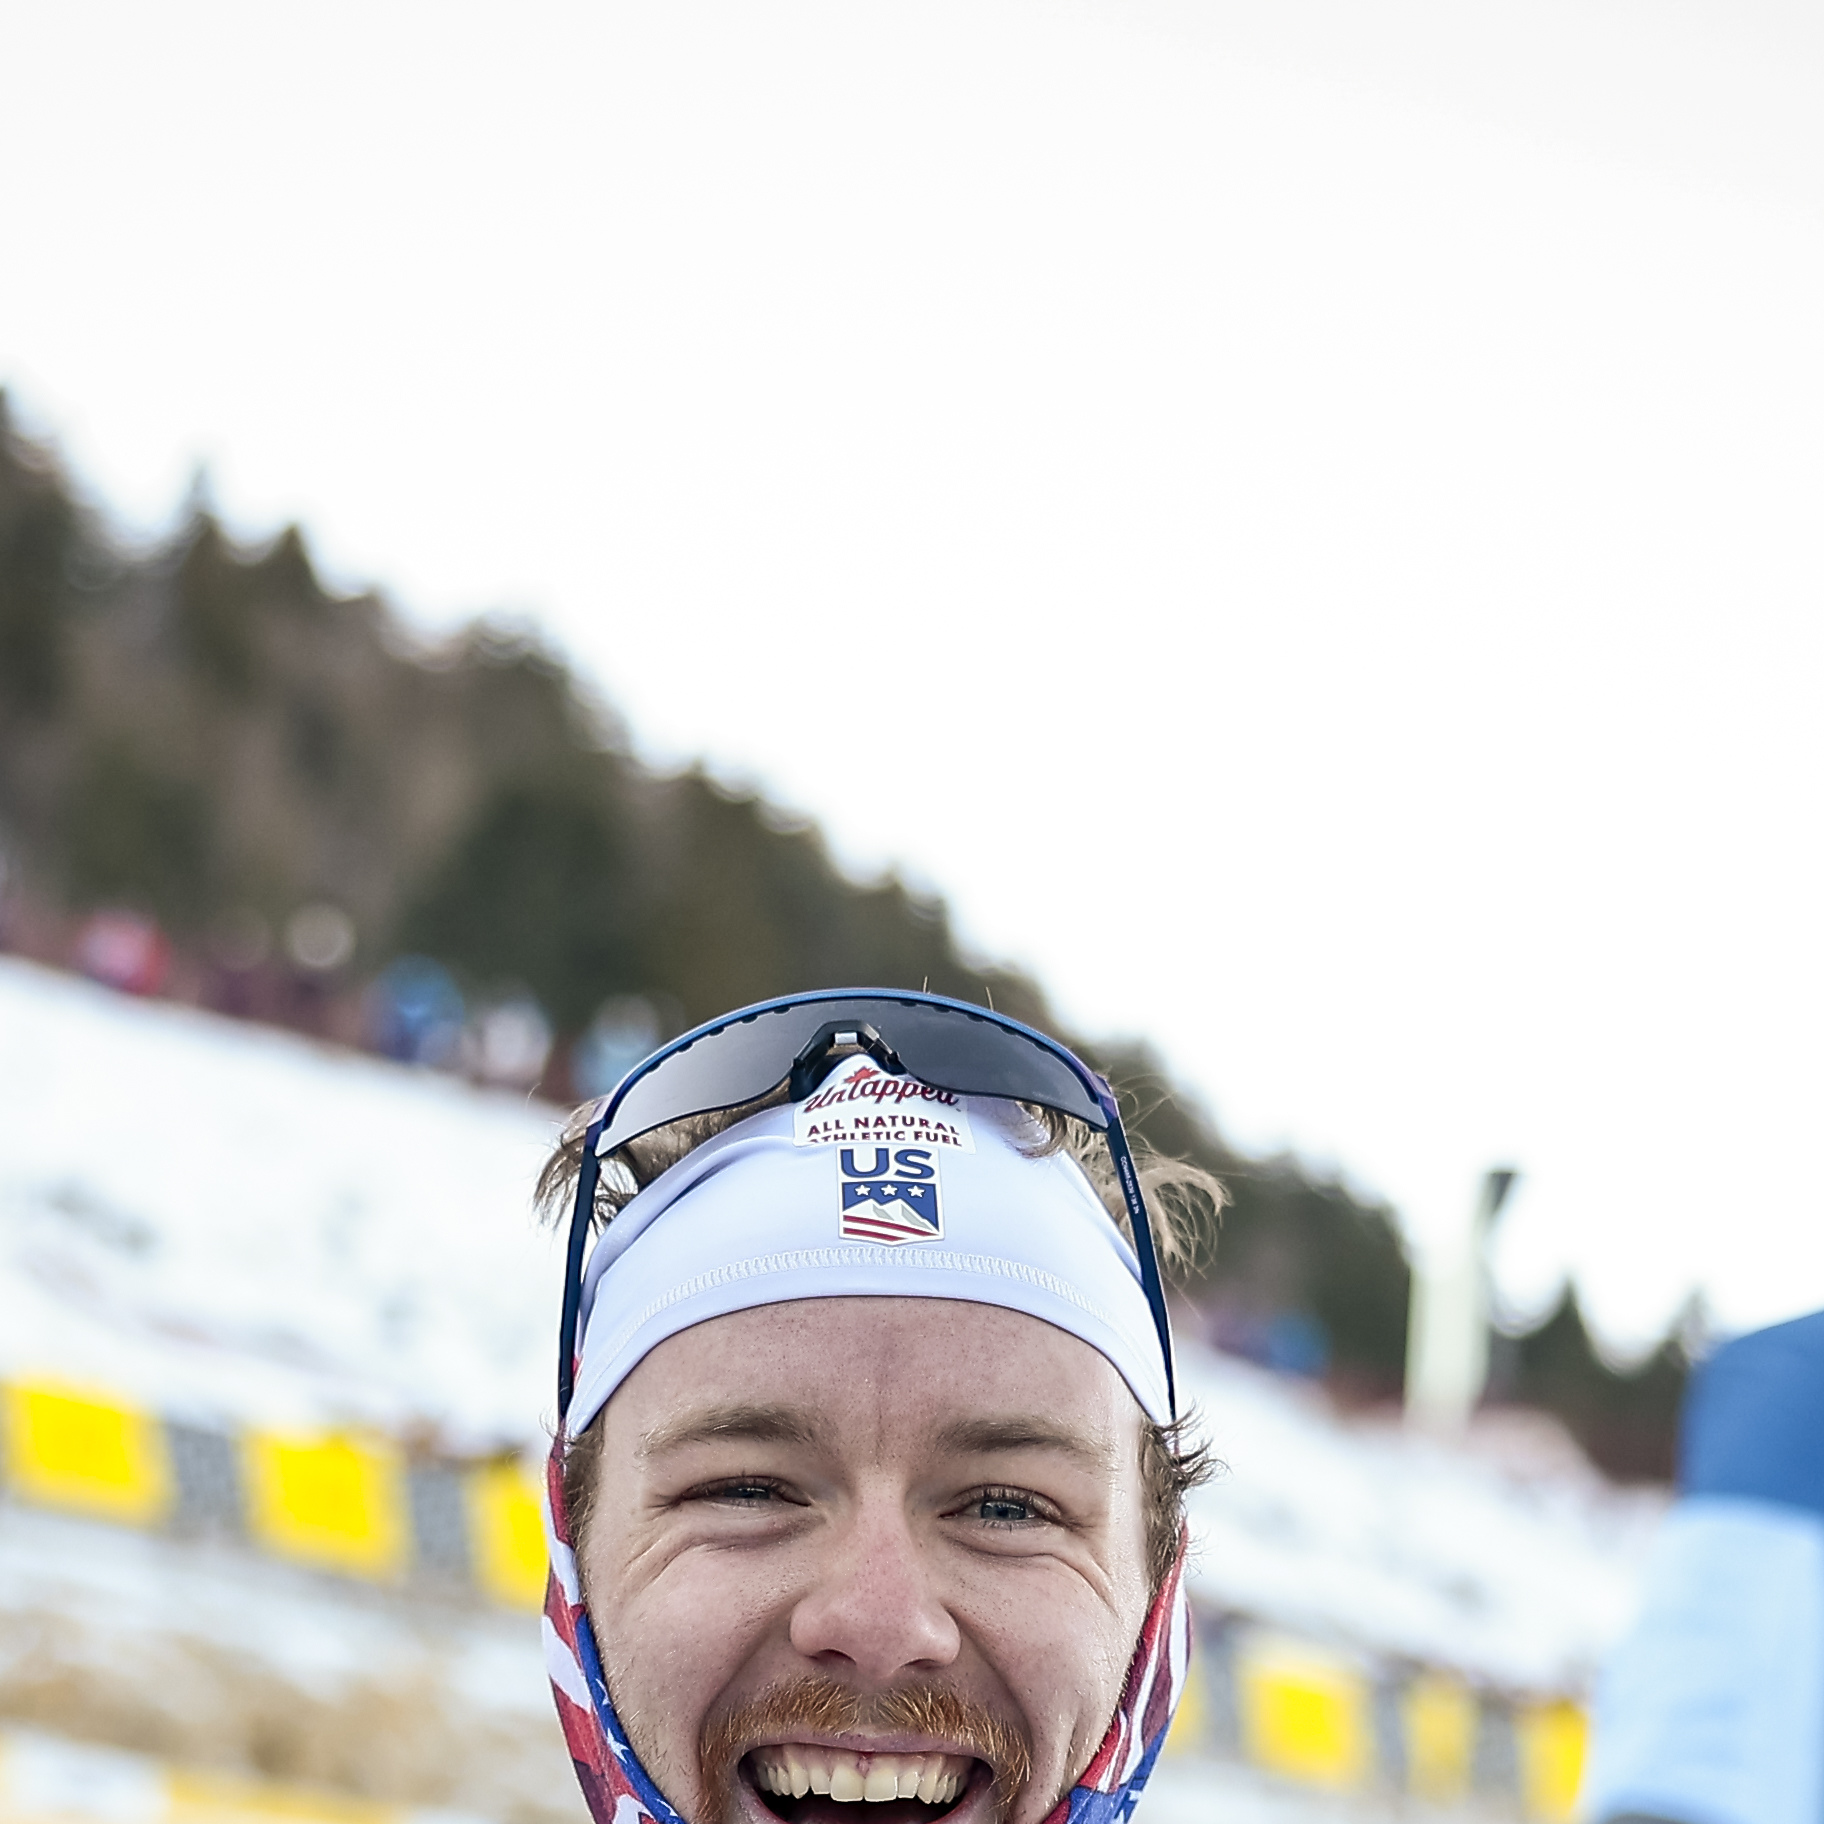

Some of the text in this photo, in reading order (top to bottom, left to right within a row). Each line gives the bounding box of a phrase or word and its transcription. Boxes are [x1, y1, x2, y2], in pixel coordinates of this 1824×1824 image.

[807, 1114, 961, 1138] ALL NATURAL
[914, 1129, 962, 1148] FUEL
[839, 1147, 936, 1180] US
